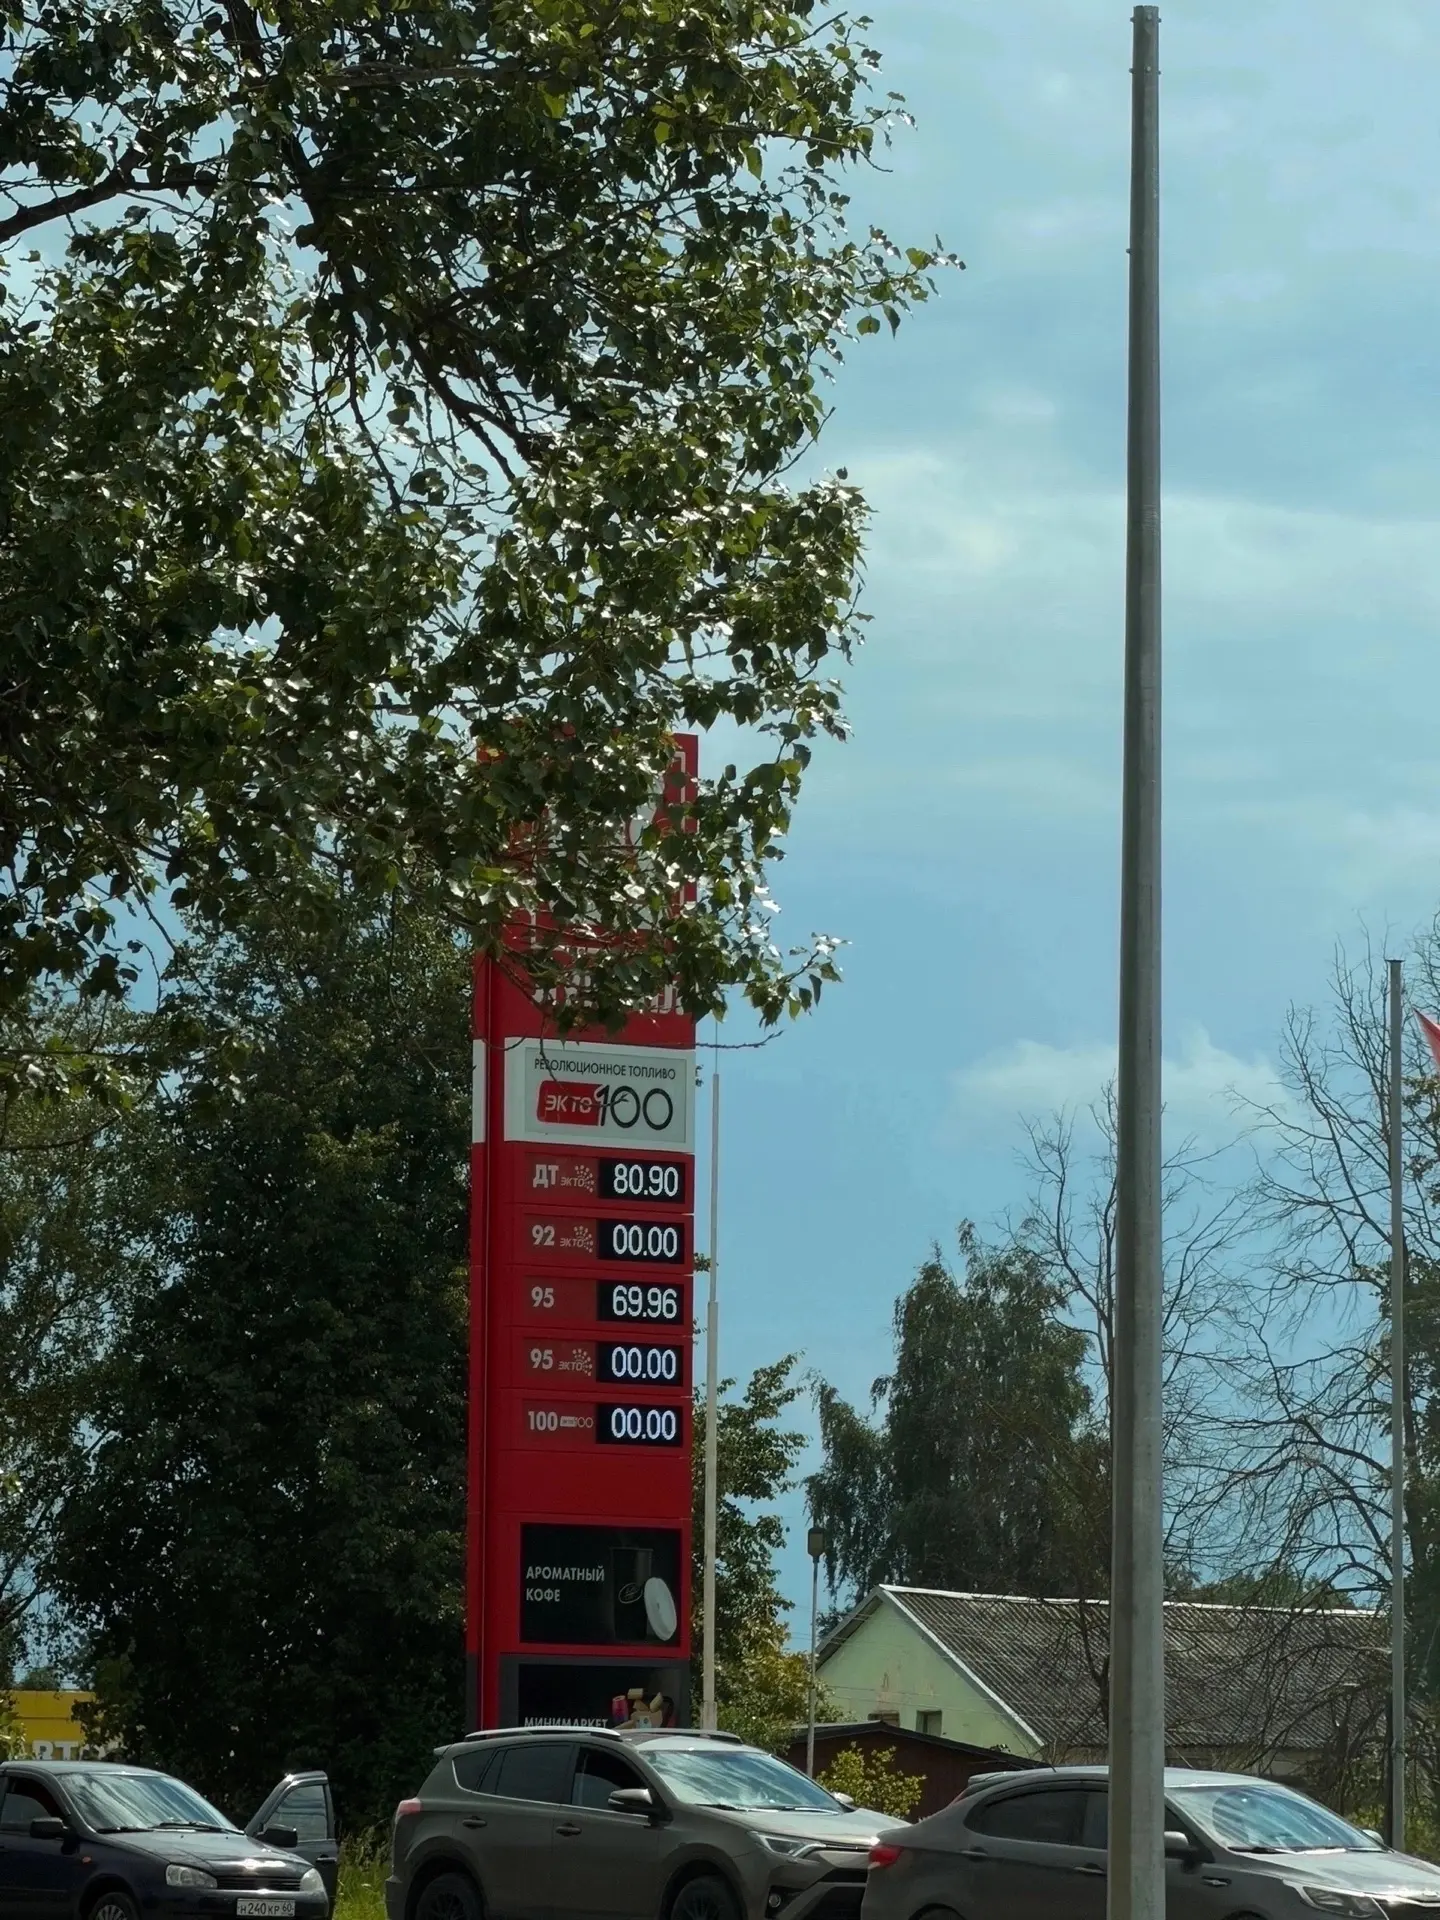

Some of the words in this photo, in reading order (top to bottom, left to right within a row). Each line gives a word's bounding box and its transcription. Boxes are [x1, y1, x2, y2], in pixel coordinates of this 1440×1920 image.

[628, 1064, 676, 1080] ТОПЛИВО
[545, 1095, 592, 1113] ЭКТО
[594, 1084, 673, 1131] 100
[532, 1164, 559, 1188] ДТ
[560, 1176, 585, 1187] ЭКТО
[613, 1163, 679, 1197] 80.90
[531, 1224, 555, 1246] 92
[559, 1237, 584, 1248] ЭКТО
[612, 1224, 678, 1258] 00.00
[531, 1286, 555, 1308] 95
[612, 1285, 677, 1319] 69.96
[530, 1348, 553, 1370] 95
[558, 1360, 583, 1371] ЭКТО
[611, 1346, 676, 1380] 00.00
[528, 1411, 558, 1431] 100
[611, 1407, 676, 1441] 00.00
[526, 1565, 605, 1582] АРОМАТНЫЙ
[526, 1588, 561, 1602] КОФЕ
[524, 1717, 608, 1728] МИНИМАРКЕТ
